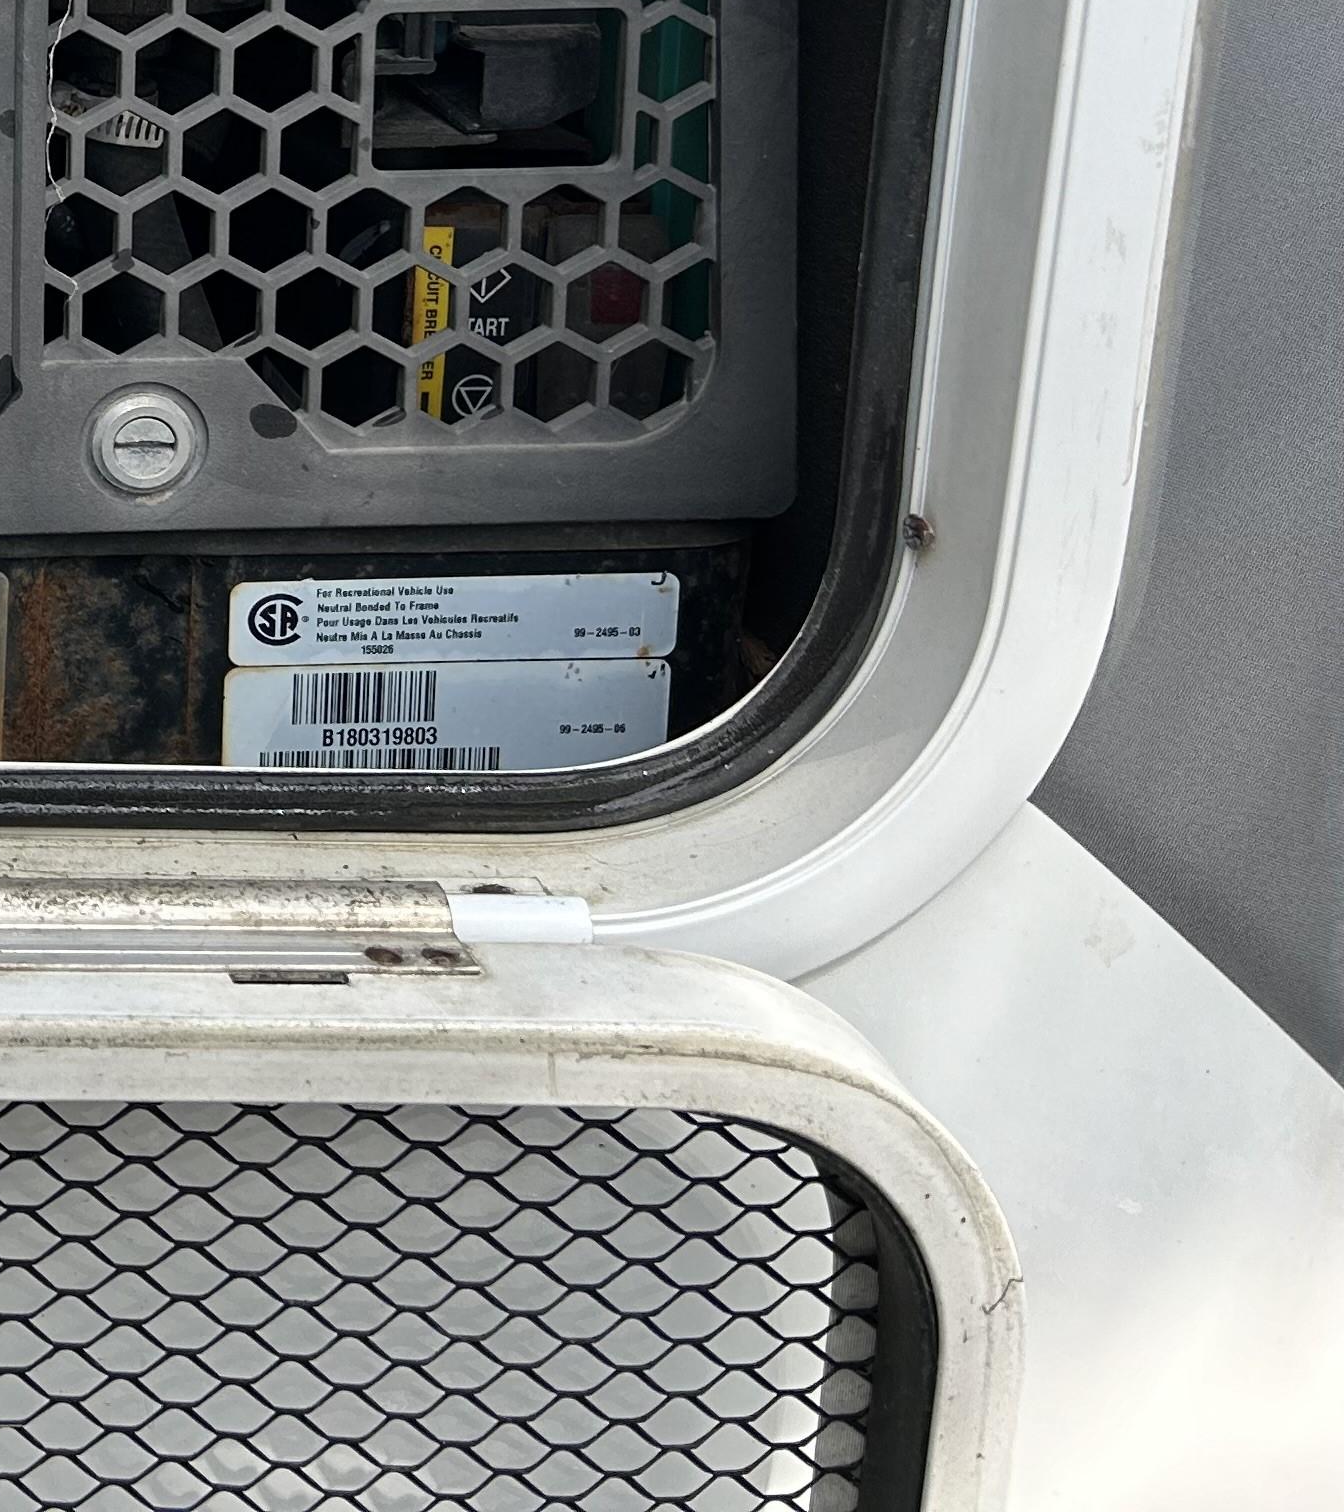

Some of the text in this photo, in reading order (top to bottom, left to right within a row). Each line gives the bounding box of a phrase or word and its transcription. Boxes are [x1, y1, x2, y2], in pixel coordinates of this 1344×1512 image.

[467, 317, 510, 336] TART
[316, 585, 454, 598] For Recreational Vehicle Use
[317, 600, 439, 613] Neutral Bonded To Frame
[316, 612, 519, 628] Pour Usage Dans Les Vehicules Recreatifs
[316, 628, 483, 642] Neutre Mis A La Masse Au Chassis
[361, 644, 394, 655] 155026
[322, 726, 438, 747] B180319803
